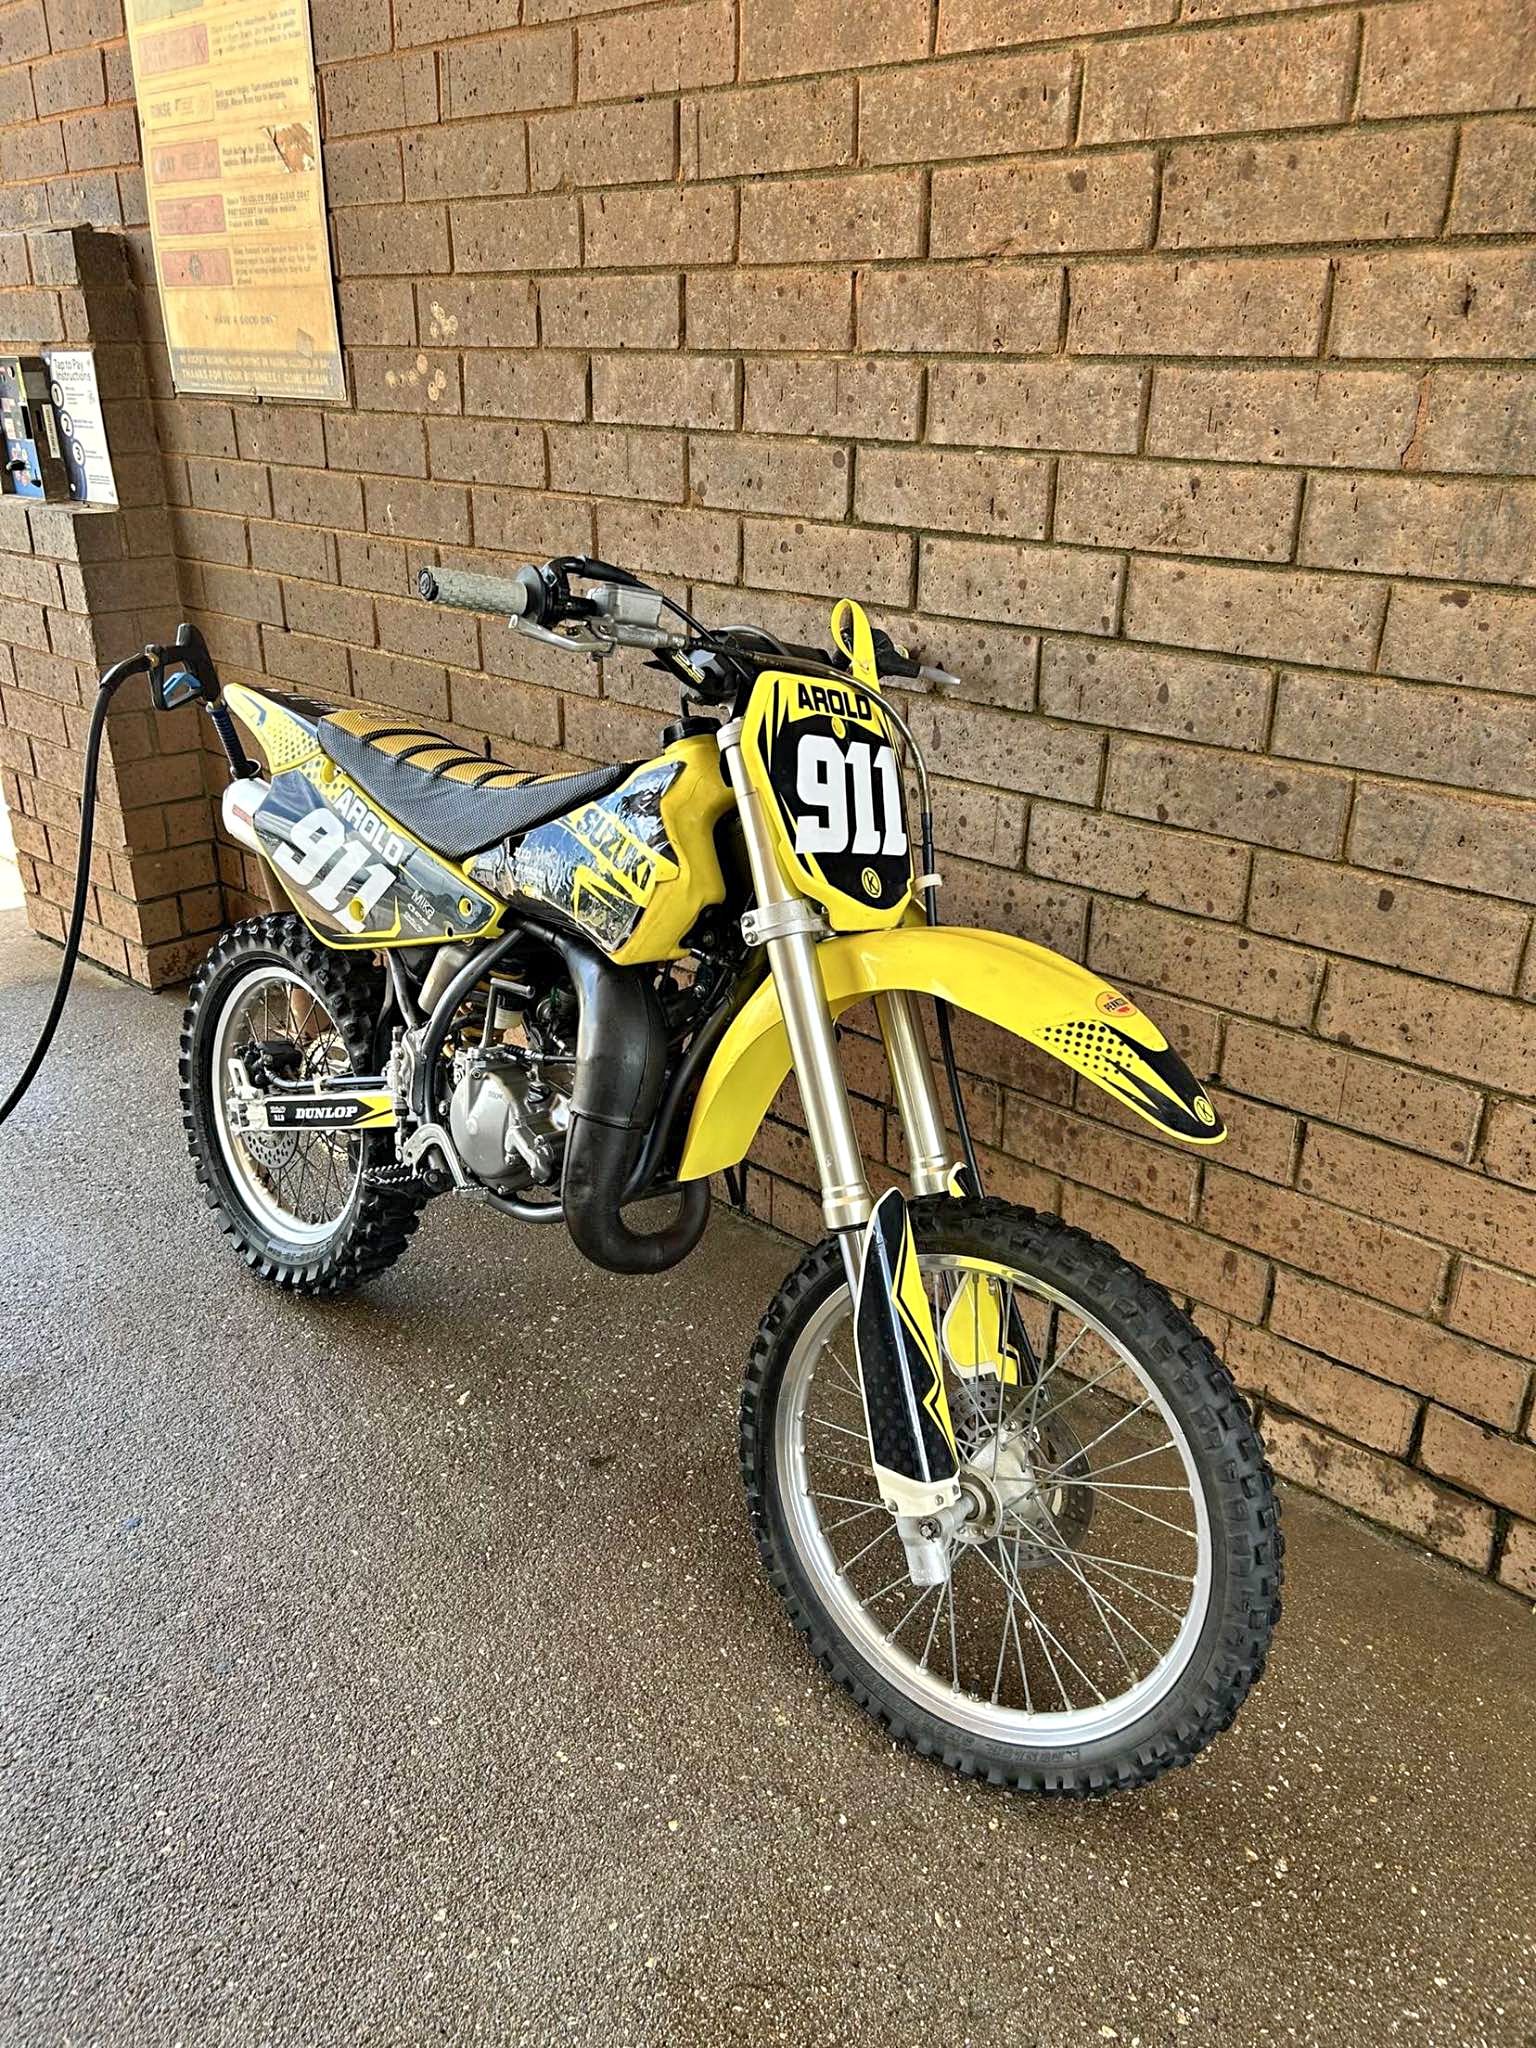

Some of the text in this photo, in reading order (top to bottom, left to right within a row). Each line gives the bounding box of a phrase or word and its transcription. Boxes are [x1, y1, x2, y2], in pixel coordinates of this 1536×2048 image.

[53, 359, 65, 371] Tap
[72, 359, 83, 372] Pay
[55, 370, 91, 382] Instructions
[798, 683, 871, 721] AROLD
[795, 733, 907, 856] 911
[333, 787, 406, 866] AROLD
[576, 807, 656, 890] SUZUKI
[272, 807, 397, 934] 911
[295, 1106, 358, 1119] DUNLOP
